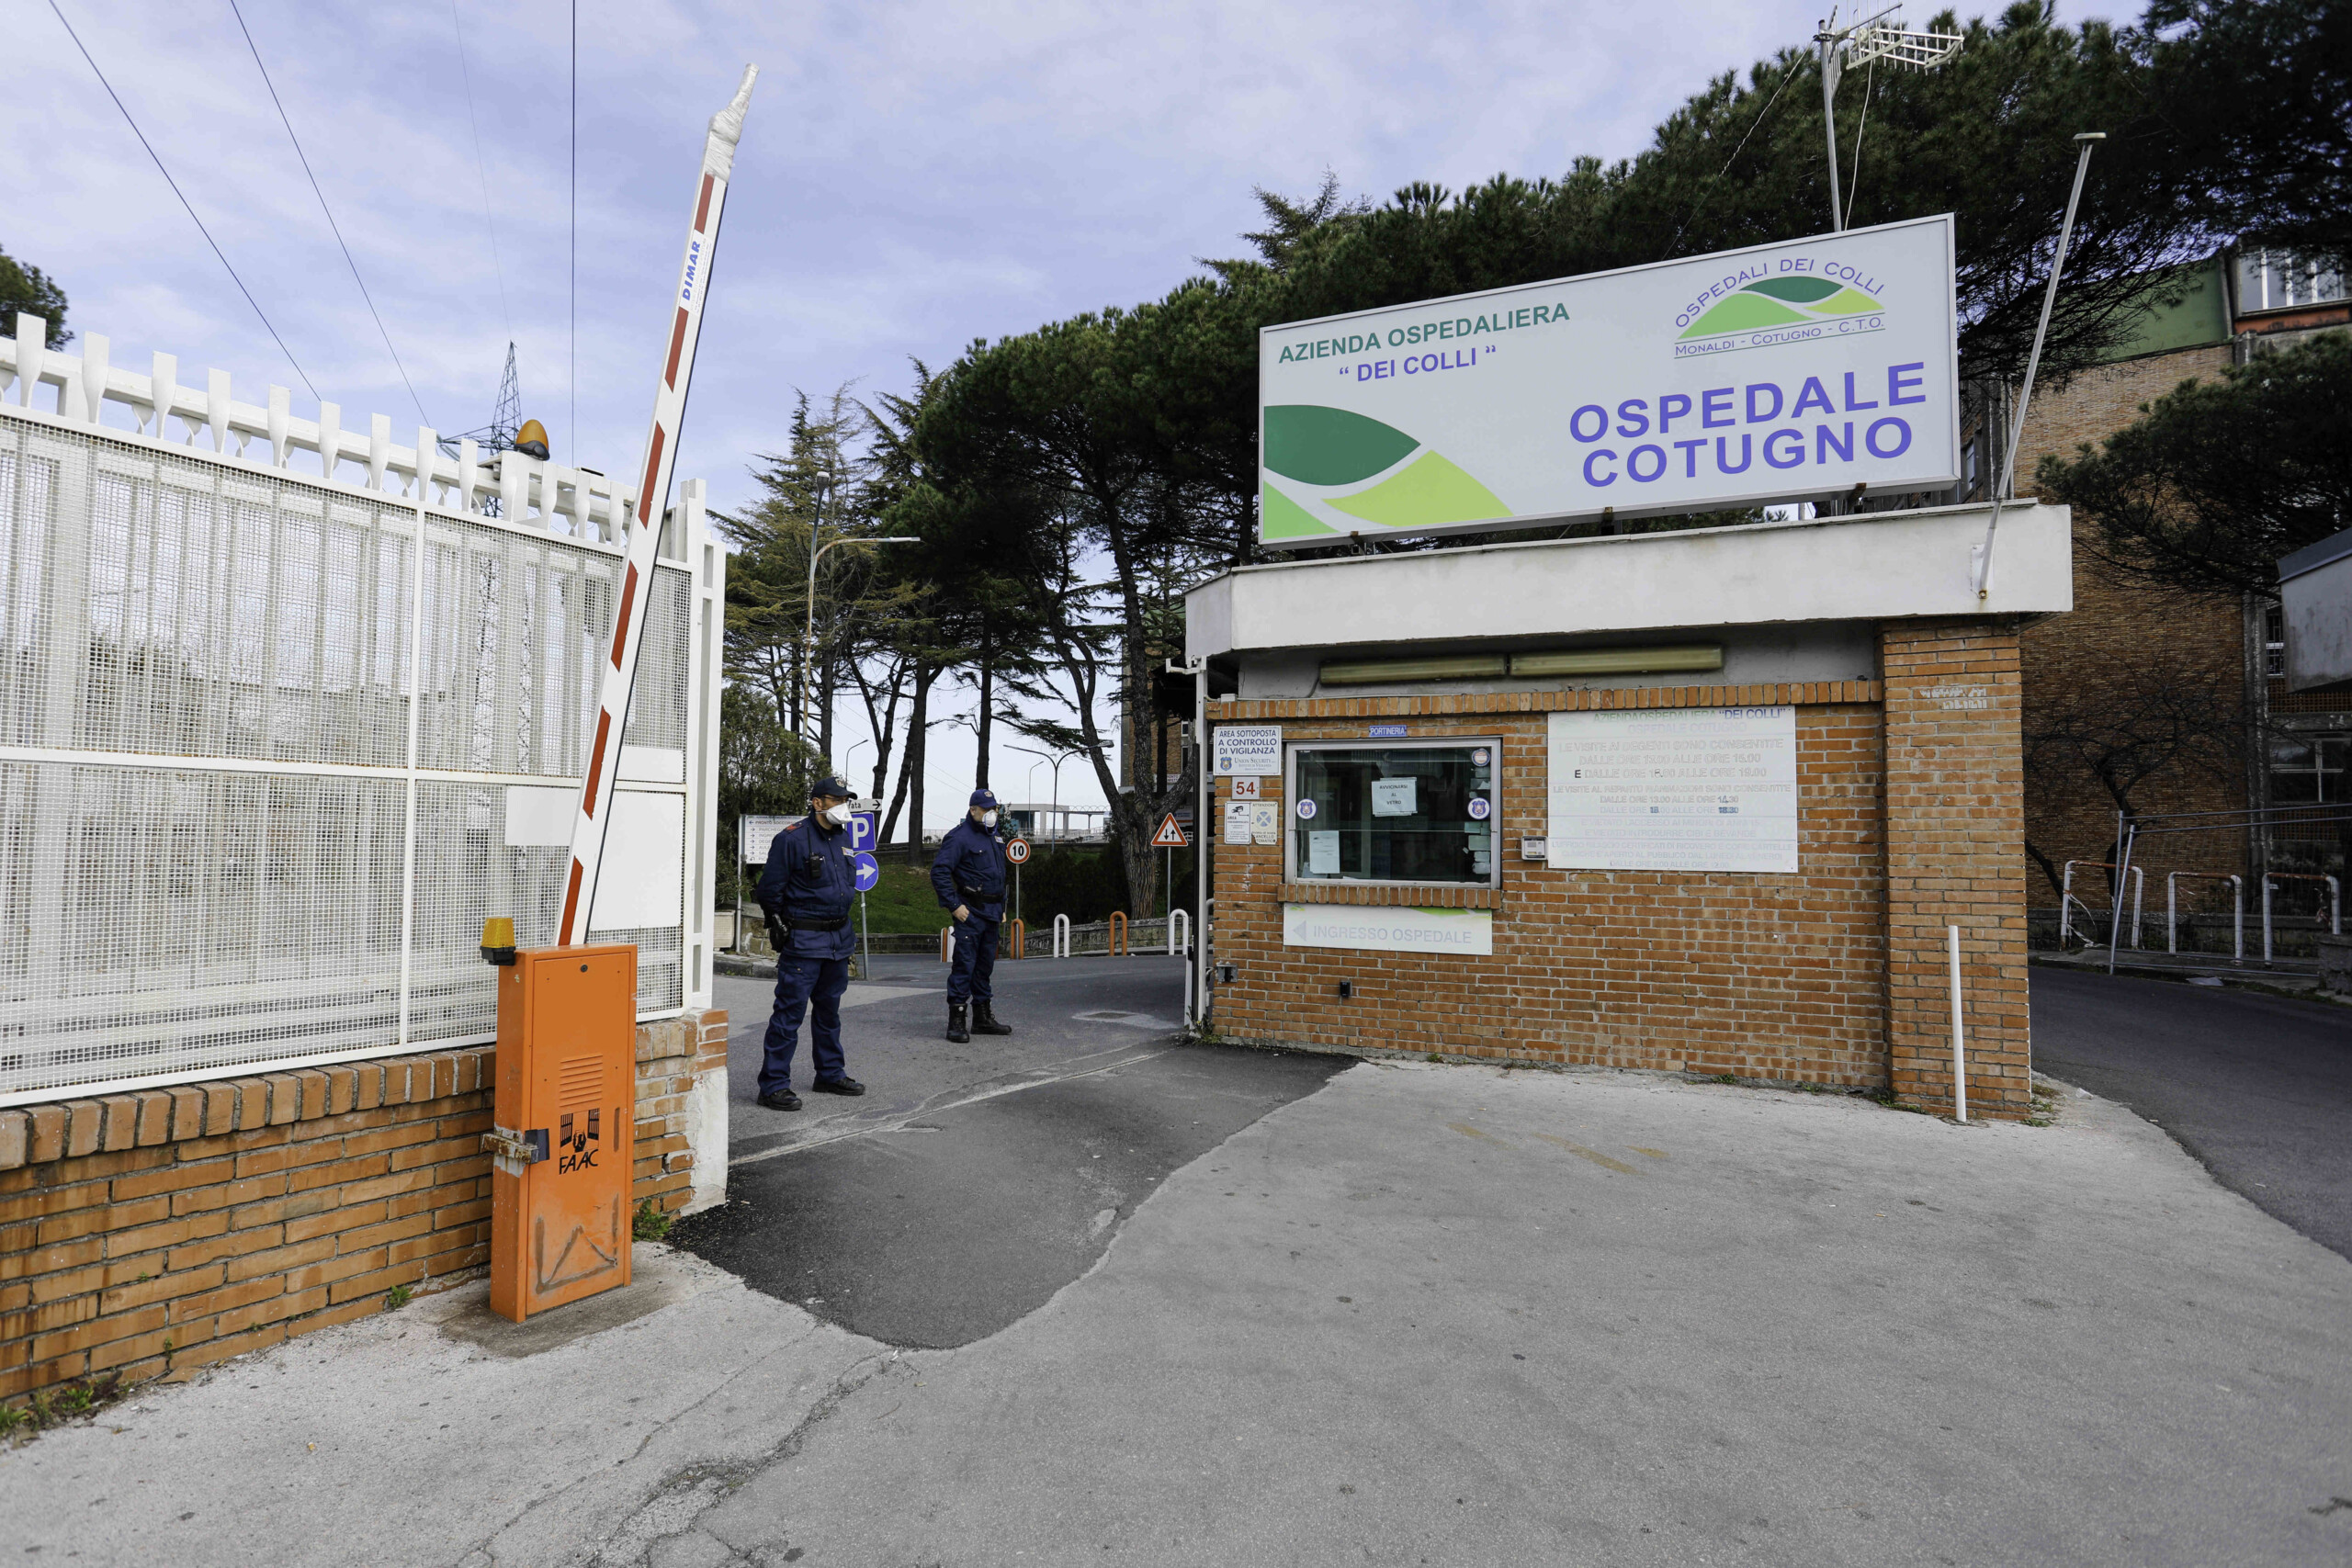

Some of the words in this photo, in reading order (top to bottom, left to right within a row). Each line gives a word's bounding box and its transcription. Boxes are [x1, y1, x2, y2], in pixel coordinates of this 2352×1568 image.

[683, 242, 700, 300] DIMAR
[1676, 263, 1768, 328] OSPEDALI
[1781, 258, 1814, 271] DEI
[1825, 262, 1884, 295] COLLI
[1279, 333, 1382, 364] AZIENDA
[1388, 303, 1570, 346] OSPEDALIERA
[1675, 340, 1735, 355] MONALDI
[1751, 327, 1821, 345] COTUGNO
[1838, 317, 1884, 333] C.T.O.
[1569, 361, 1927, 444] OSPEDALE
[1582, 416, 1913, 487] COTUGNO
[1370, 727, 1405, 735] PORTINERIA
[1628, 723, 1686, 734] OSPEDALE
[1690, 722, 1747, 733] COTUGNO
[1574, 769, 1581, 778] E
[1236, 782, 1255, 795] 54
[853, 818, 869, 848] P
[1012, 845, 1024, 856] 10
[1314, 926, 1387, 940] INGRESSO
[1392, 929, 1472, 943] OSPEDALE
[560, 1148, 599, 1174] FAAC
